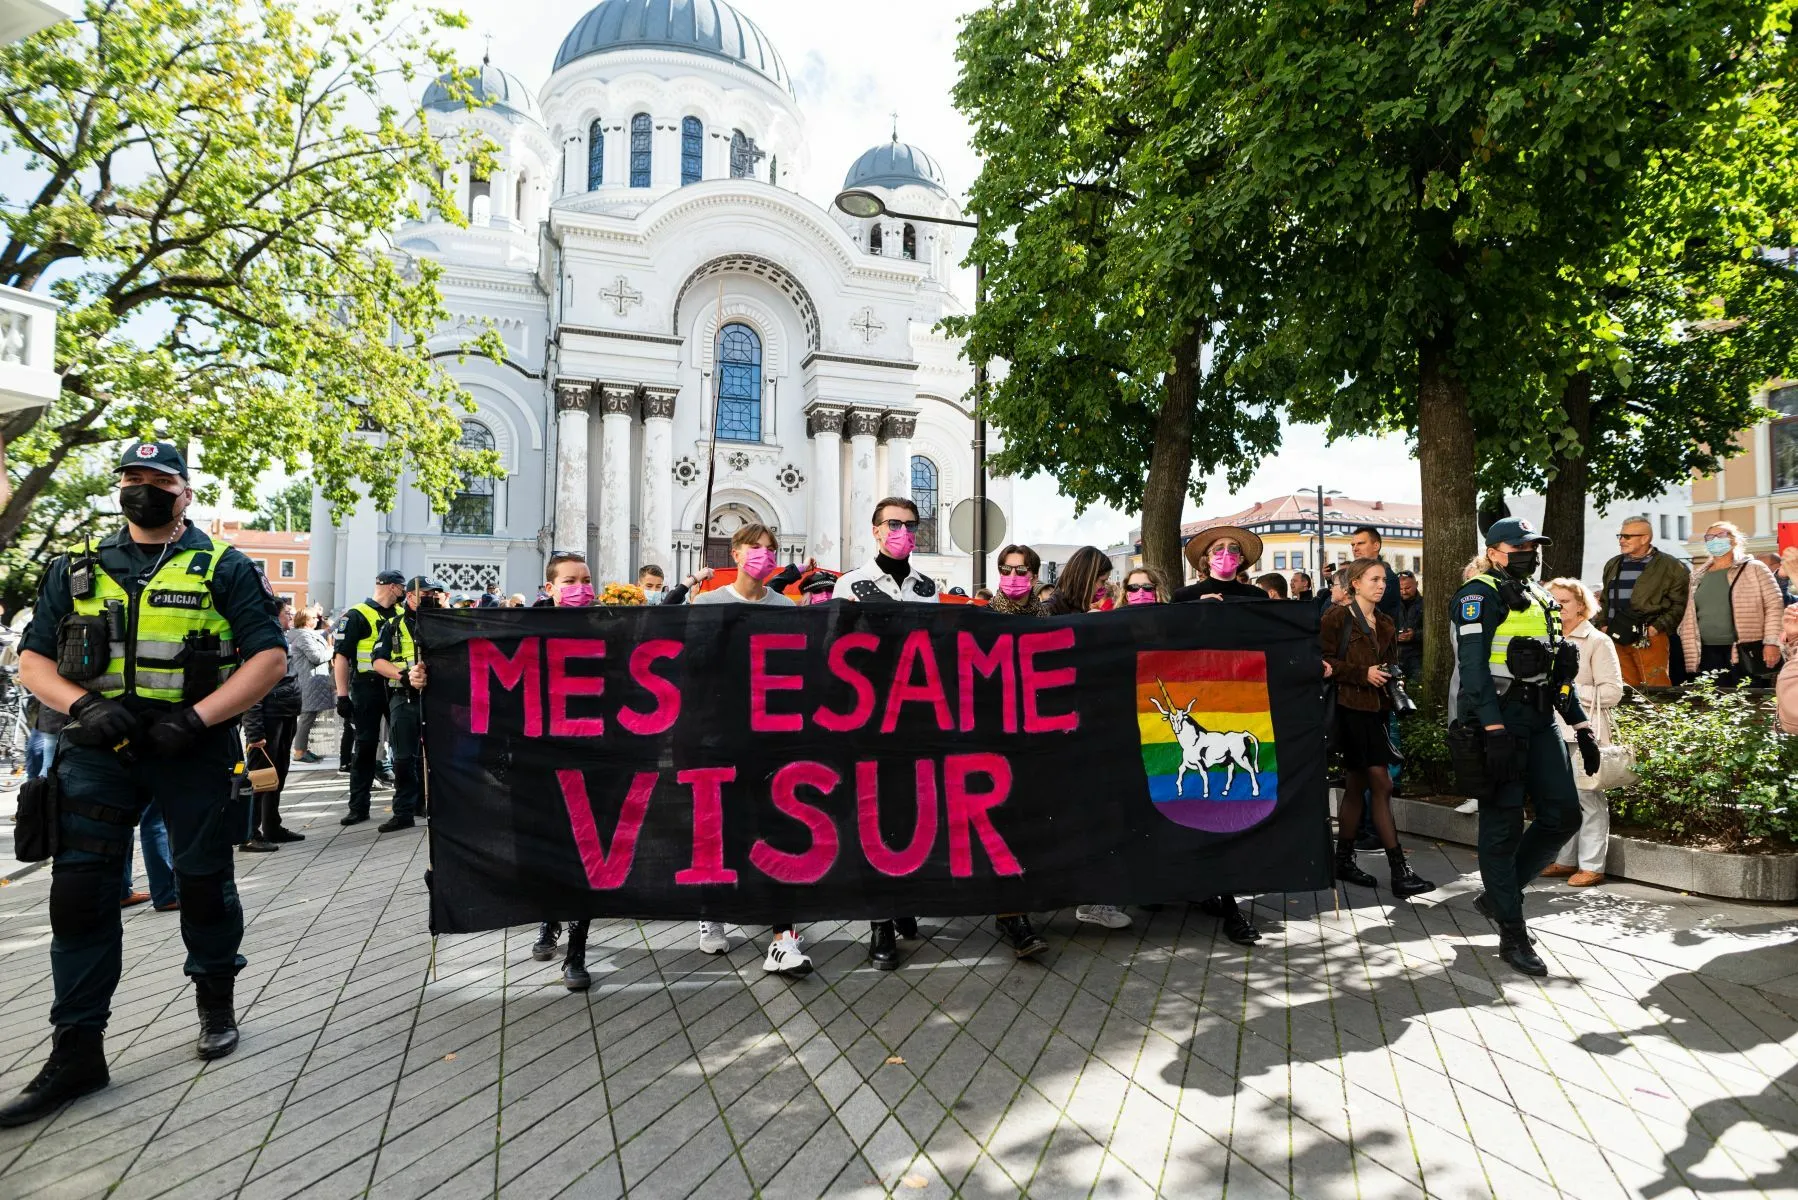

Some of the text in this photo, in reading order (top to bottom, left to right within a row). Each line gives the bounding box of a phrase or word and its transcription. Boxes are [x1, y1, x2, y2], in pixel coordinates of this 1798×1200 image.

[153, 594, 198, 605] POLICIJA
[469, 627, 1079, 737] MES ESAME
[556, 752, 1023, 889] VISUR
